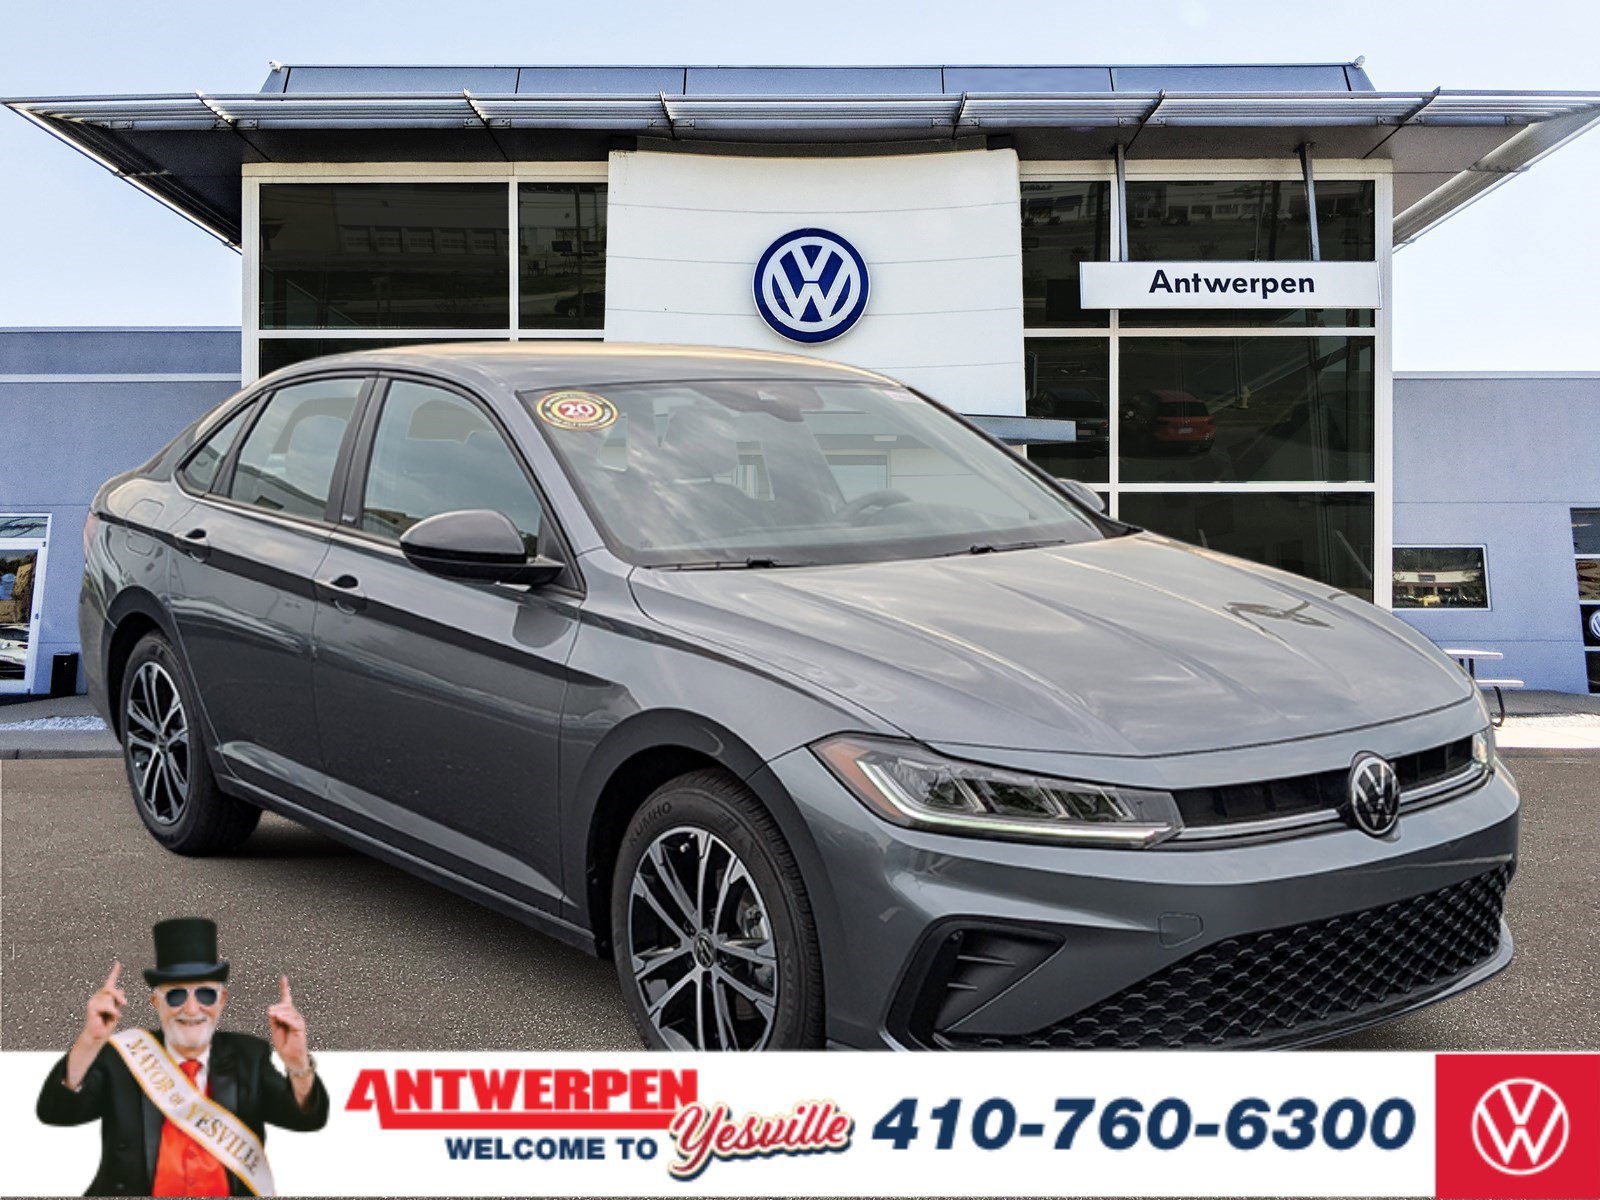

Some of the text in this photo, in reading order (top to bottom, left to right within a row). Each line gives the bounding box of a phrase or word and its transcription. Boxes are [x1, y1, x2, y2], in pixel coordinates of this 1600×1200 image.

[1149, 269, 1315, 299] Antwerpen
[560, 403, 595, 416] 20
[126, 1038, 175, 1093] MAYOR
[184, 1102, 258, 1175] YESVILLE
